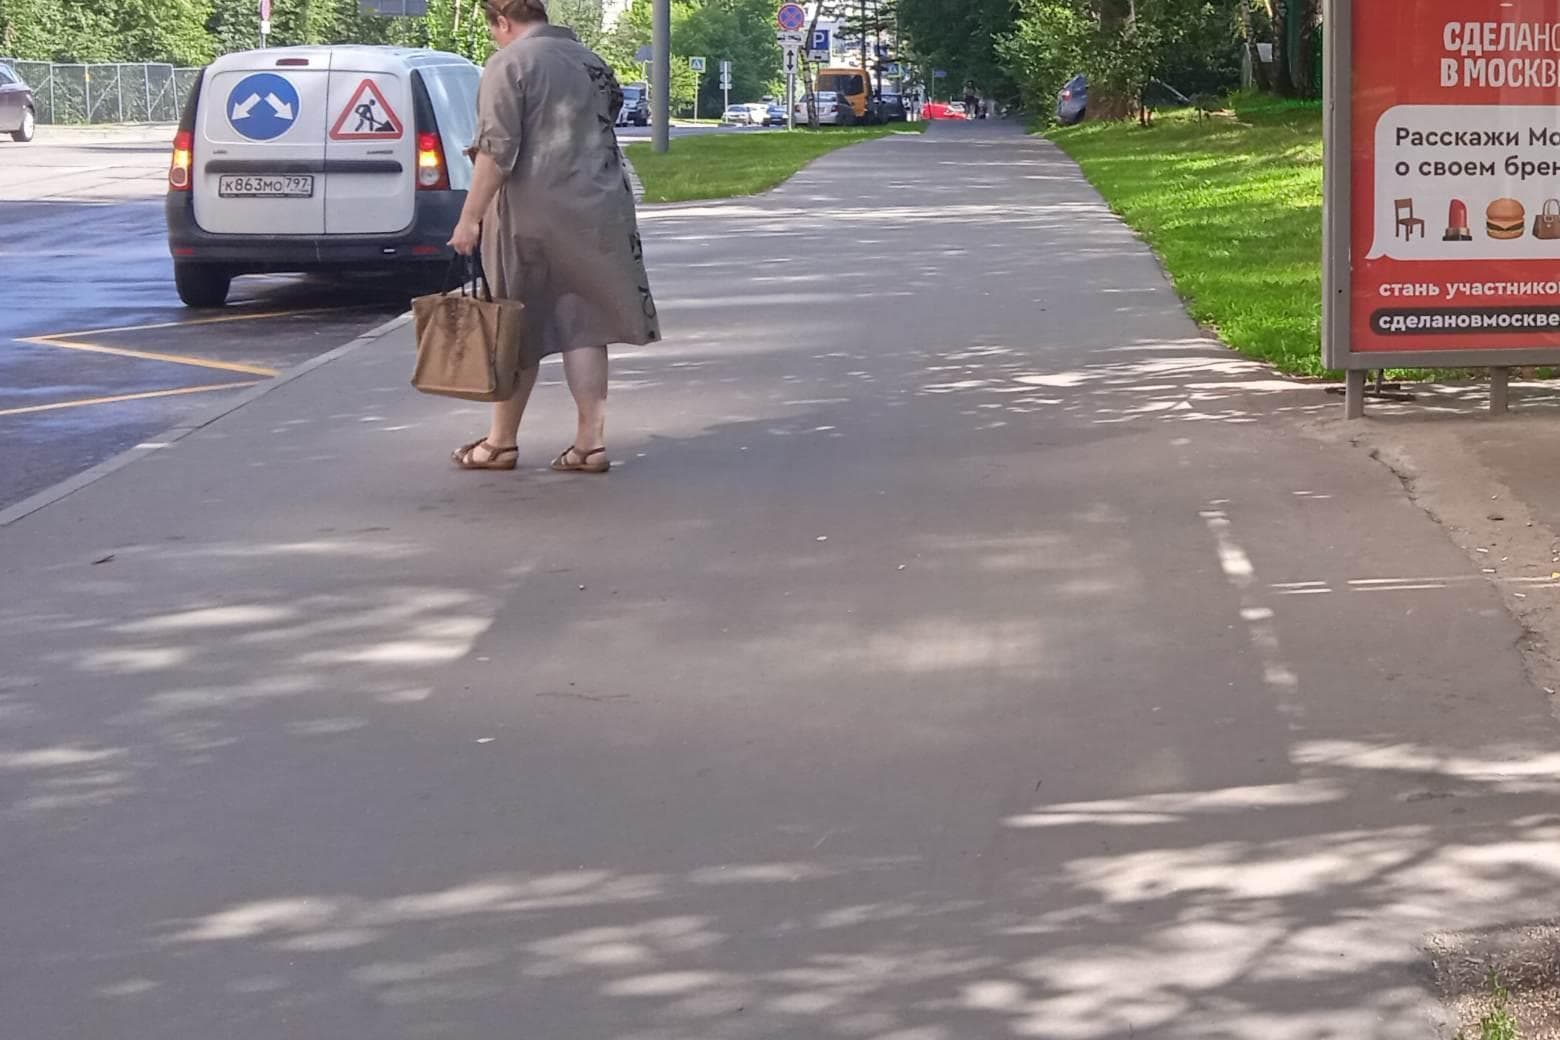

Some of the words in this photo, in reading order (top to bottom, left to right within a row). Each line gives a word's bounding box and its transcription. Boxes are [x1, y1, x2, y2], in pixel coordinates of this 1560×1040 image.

[1440, 58, 1458, 88] В
[1395, 127, 1519, 147] Расскажи
[1395, 162, 1410, 176] о
[1418, 162, 1496, 176] своем
[1379, 282, 1440, 297] стань
